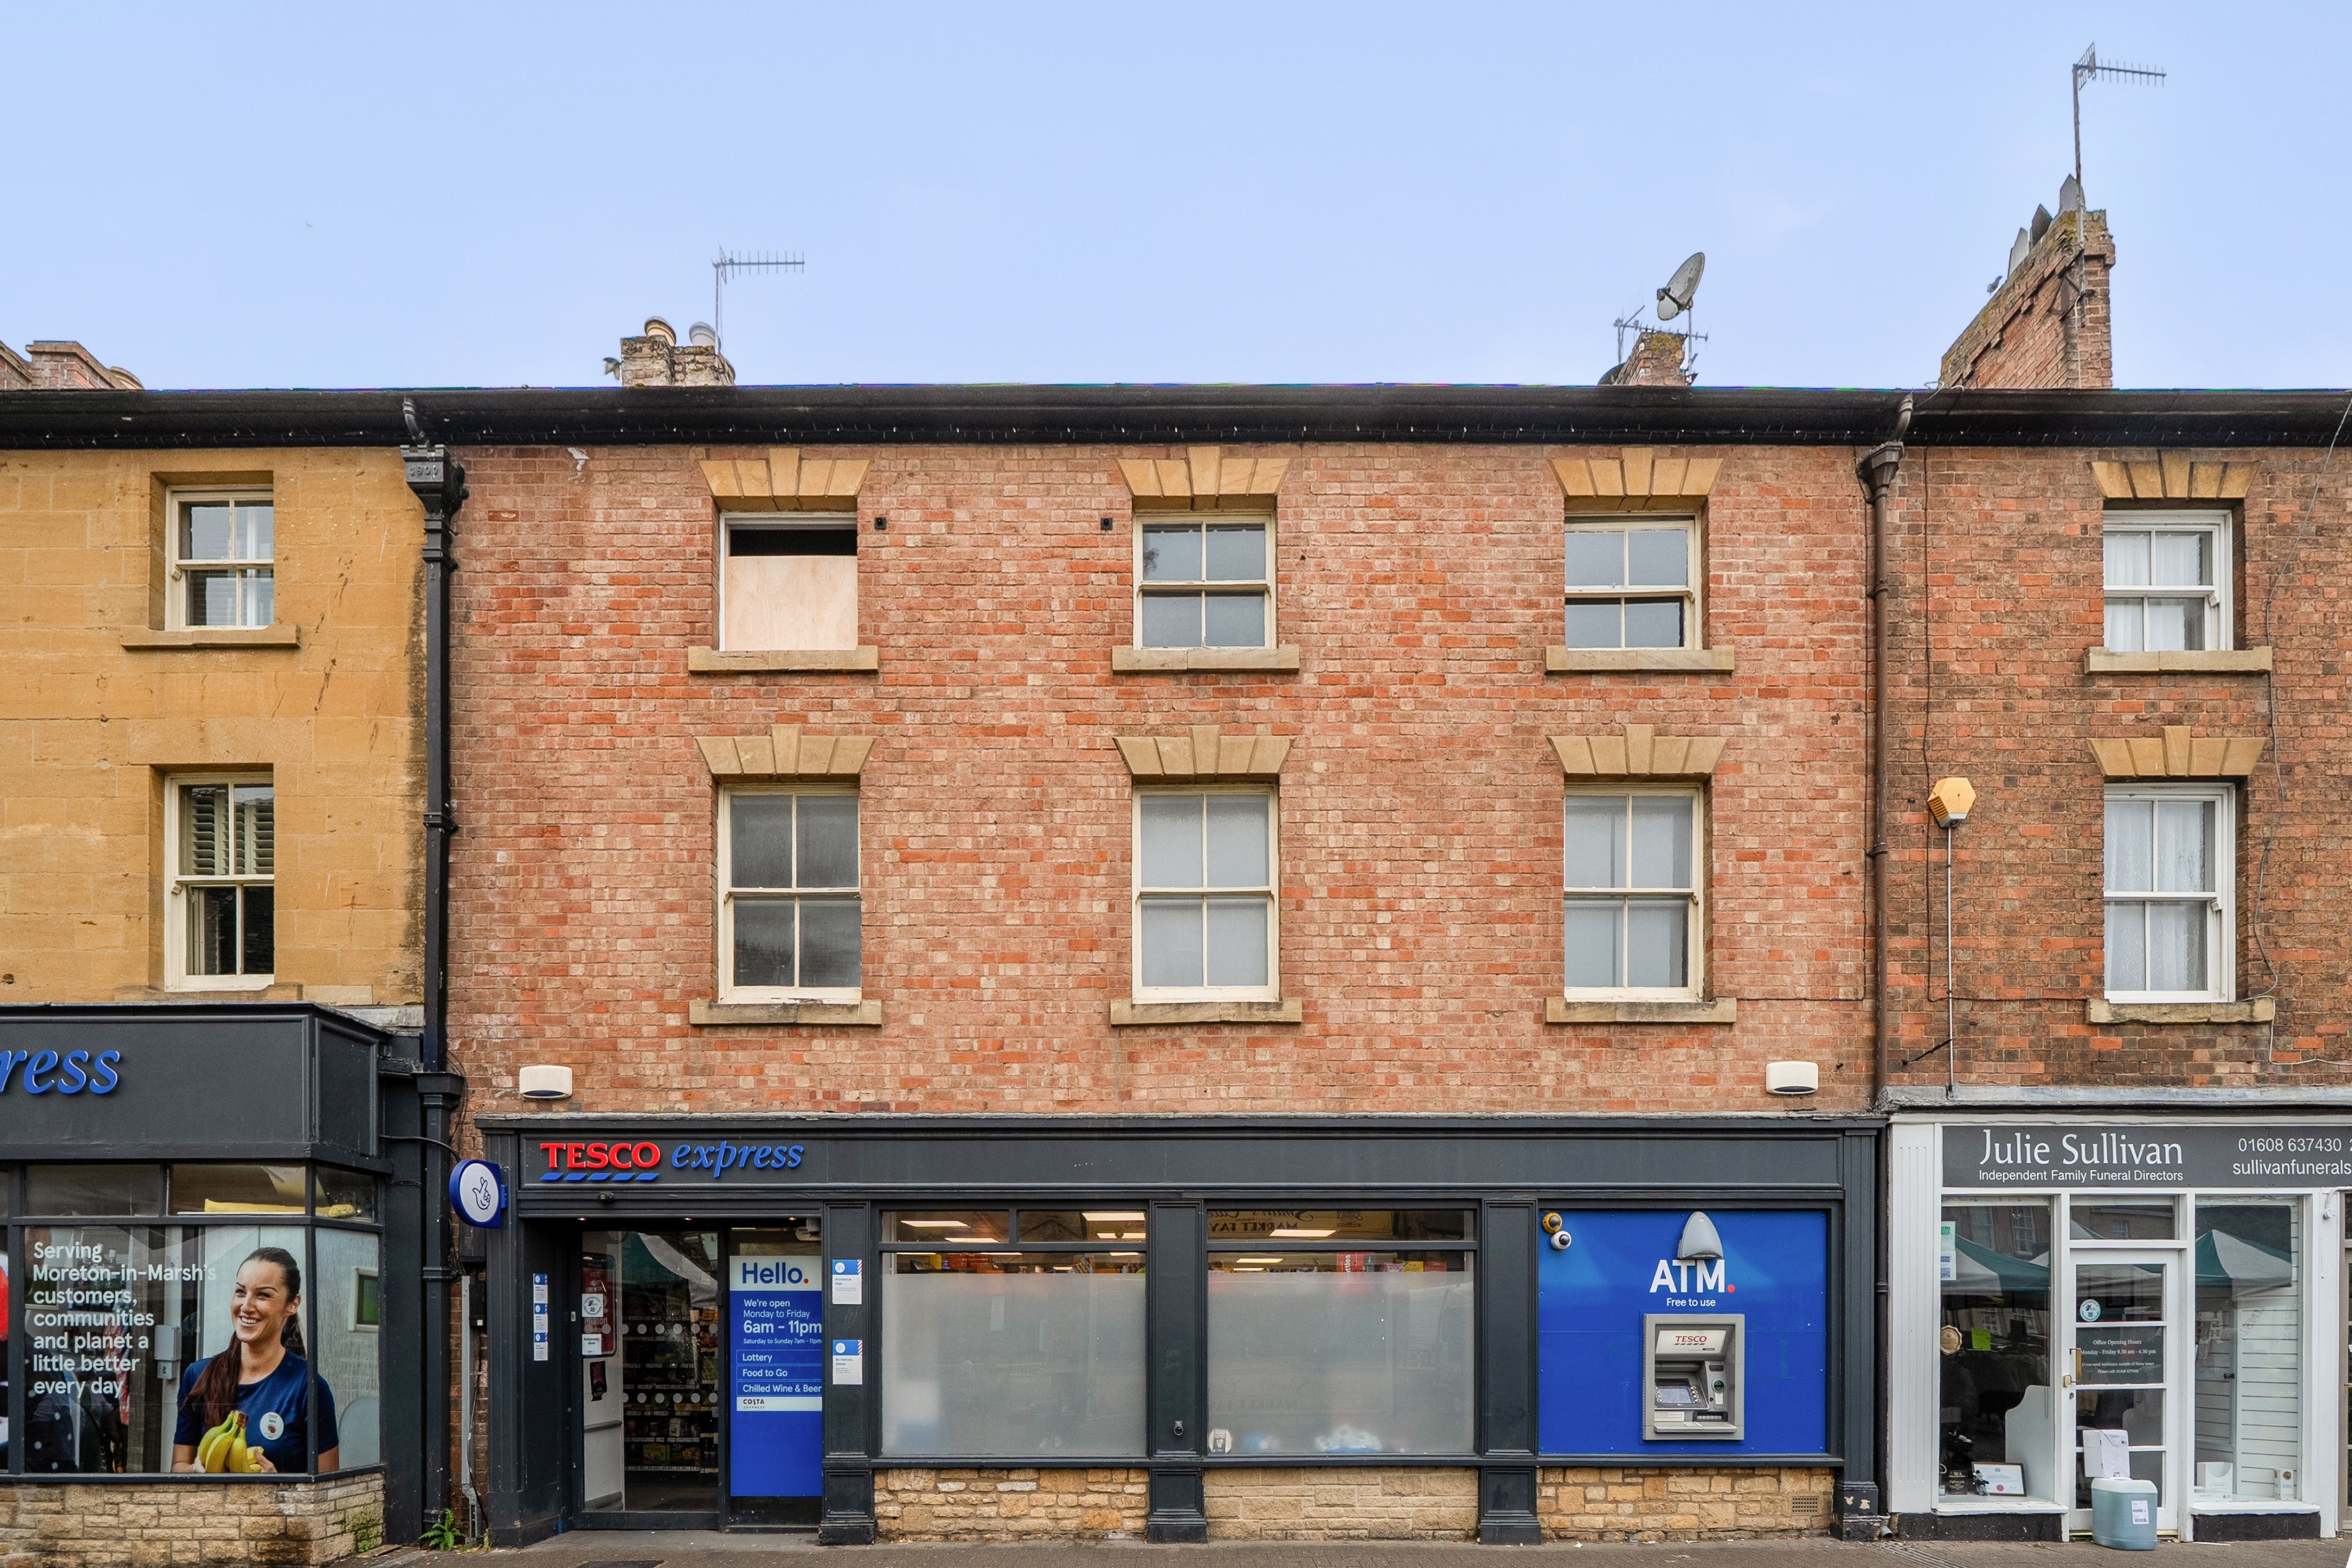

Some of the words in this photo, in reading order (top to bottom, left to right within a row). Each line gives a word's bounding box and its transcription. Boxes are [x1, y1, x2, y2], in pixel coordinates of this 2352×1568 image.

[0, 1050, 120, 1094] ress
[1979, 1129, 2050, 1165] Julie
[2062, 1133, 2183, 1165] Sullivan
[2238, 1138, 2284, 1152] 01608
[2288, 1138, 2341, 1152] 637430
[539, 1142, 661, 1169] TESCO
[671, 1141, 804, 1178] express
[2233, 1159, 2351, 1175] sullivanfunerals
[1979, 1169, 2048, 1183] Independent
[2051, 1169, 2087, 1183] Family
[2090, 1169, 2130, 1180] Funeral
[2134, 1169, 2183, 1180] Directors
[33, 1241, 102, 1263] Serving
[33, 1264, 217, 1281] Moreton-in-Marsh's
[742, 1262, 809, 1284] Hello.
[33, 1287, 137, 1307] customers,
[769, 1300, 790, 1309] open
[1666, 1297, 1687, 1306] Free
[1688, 1298, 1698, 1306] to
[33, 1309, 155, 1326] communities
[743, 1310, 774, 1320] Monday
[786, 1310, 810, 1319] Friday
[743, 1320, 774, 1333] 6am
[788, 1320, 822, 1337] 11pm
[33, 1332, 68, 1349] and
[74, 1332, 133, 1353] planet
[138, 1335, 149, 1349] a
[33, 1354, 75, 1372] little
[81, 1354, 140, 1372] better
[742, 1353, 772, 1363] Lottery
[742, 1368, 763, 1377] Food
[776, 1368, 788, 1377] Go
[33, 1380, 86, 1399] every
[91, 1376, 124, 1399] day
